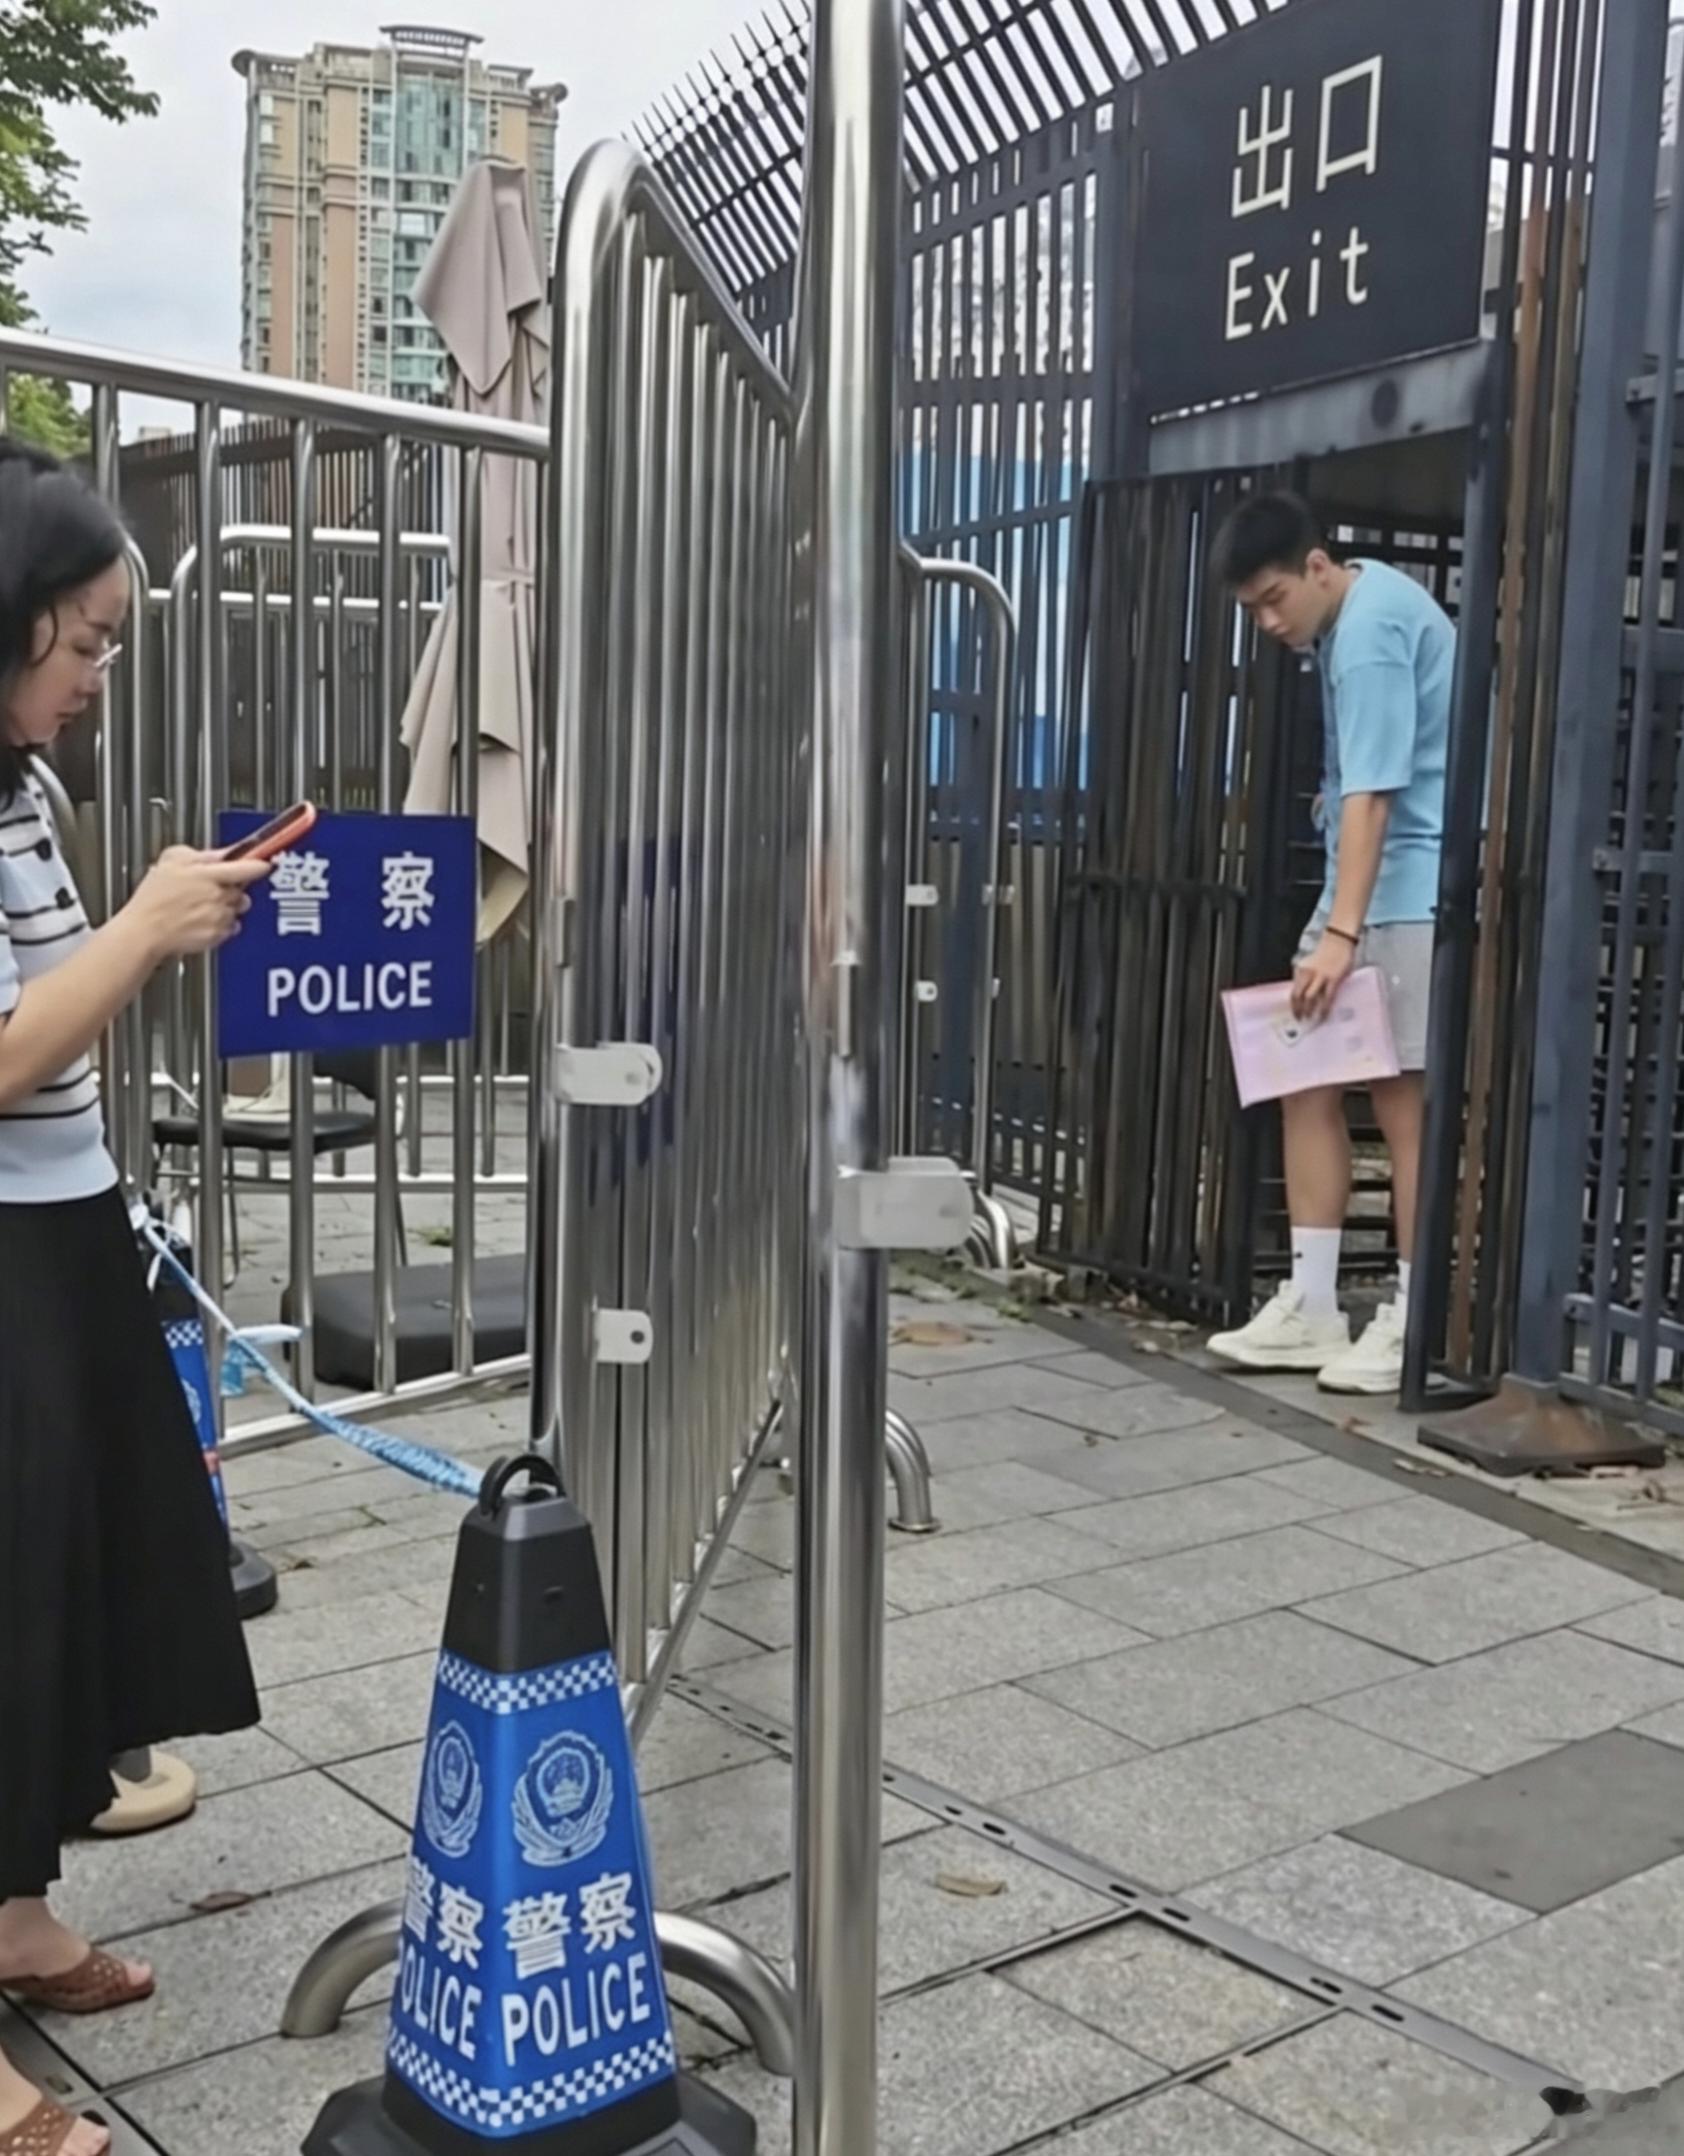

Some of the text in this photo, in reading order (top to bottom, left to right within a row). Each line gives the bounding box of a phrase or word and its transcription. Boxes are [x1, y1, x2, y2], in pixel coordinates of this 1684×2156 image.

[1231, 54, 1382, 218] 出口
[1226, 227, 1369, 340] Exit
[269, 850, 436, 936] 警察
[267, 960, 433, 1018] POLICE
[502, 1871, 638, 1980] 警察
[400, 1936, 483, 2061] OLICE
[501, 1952, 650, 2068] POLICE
